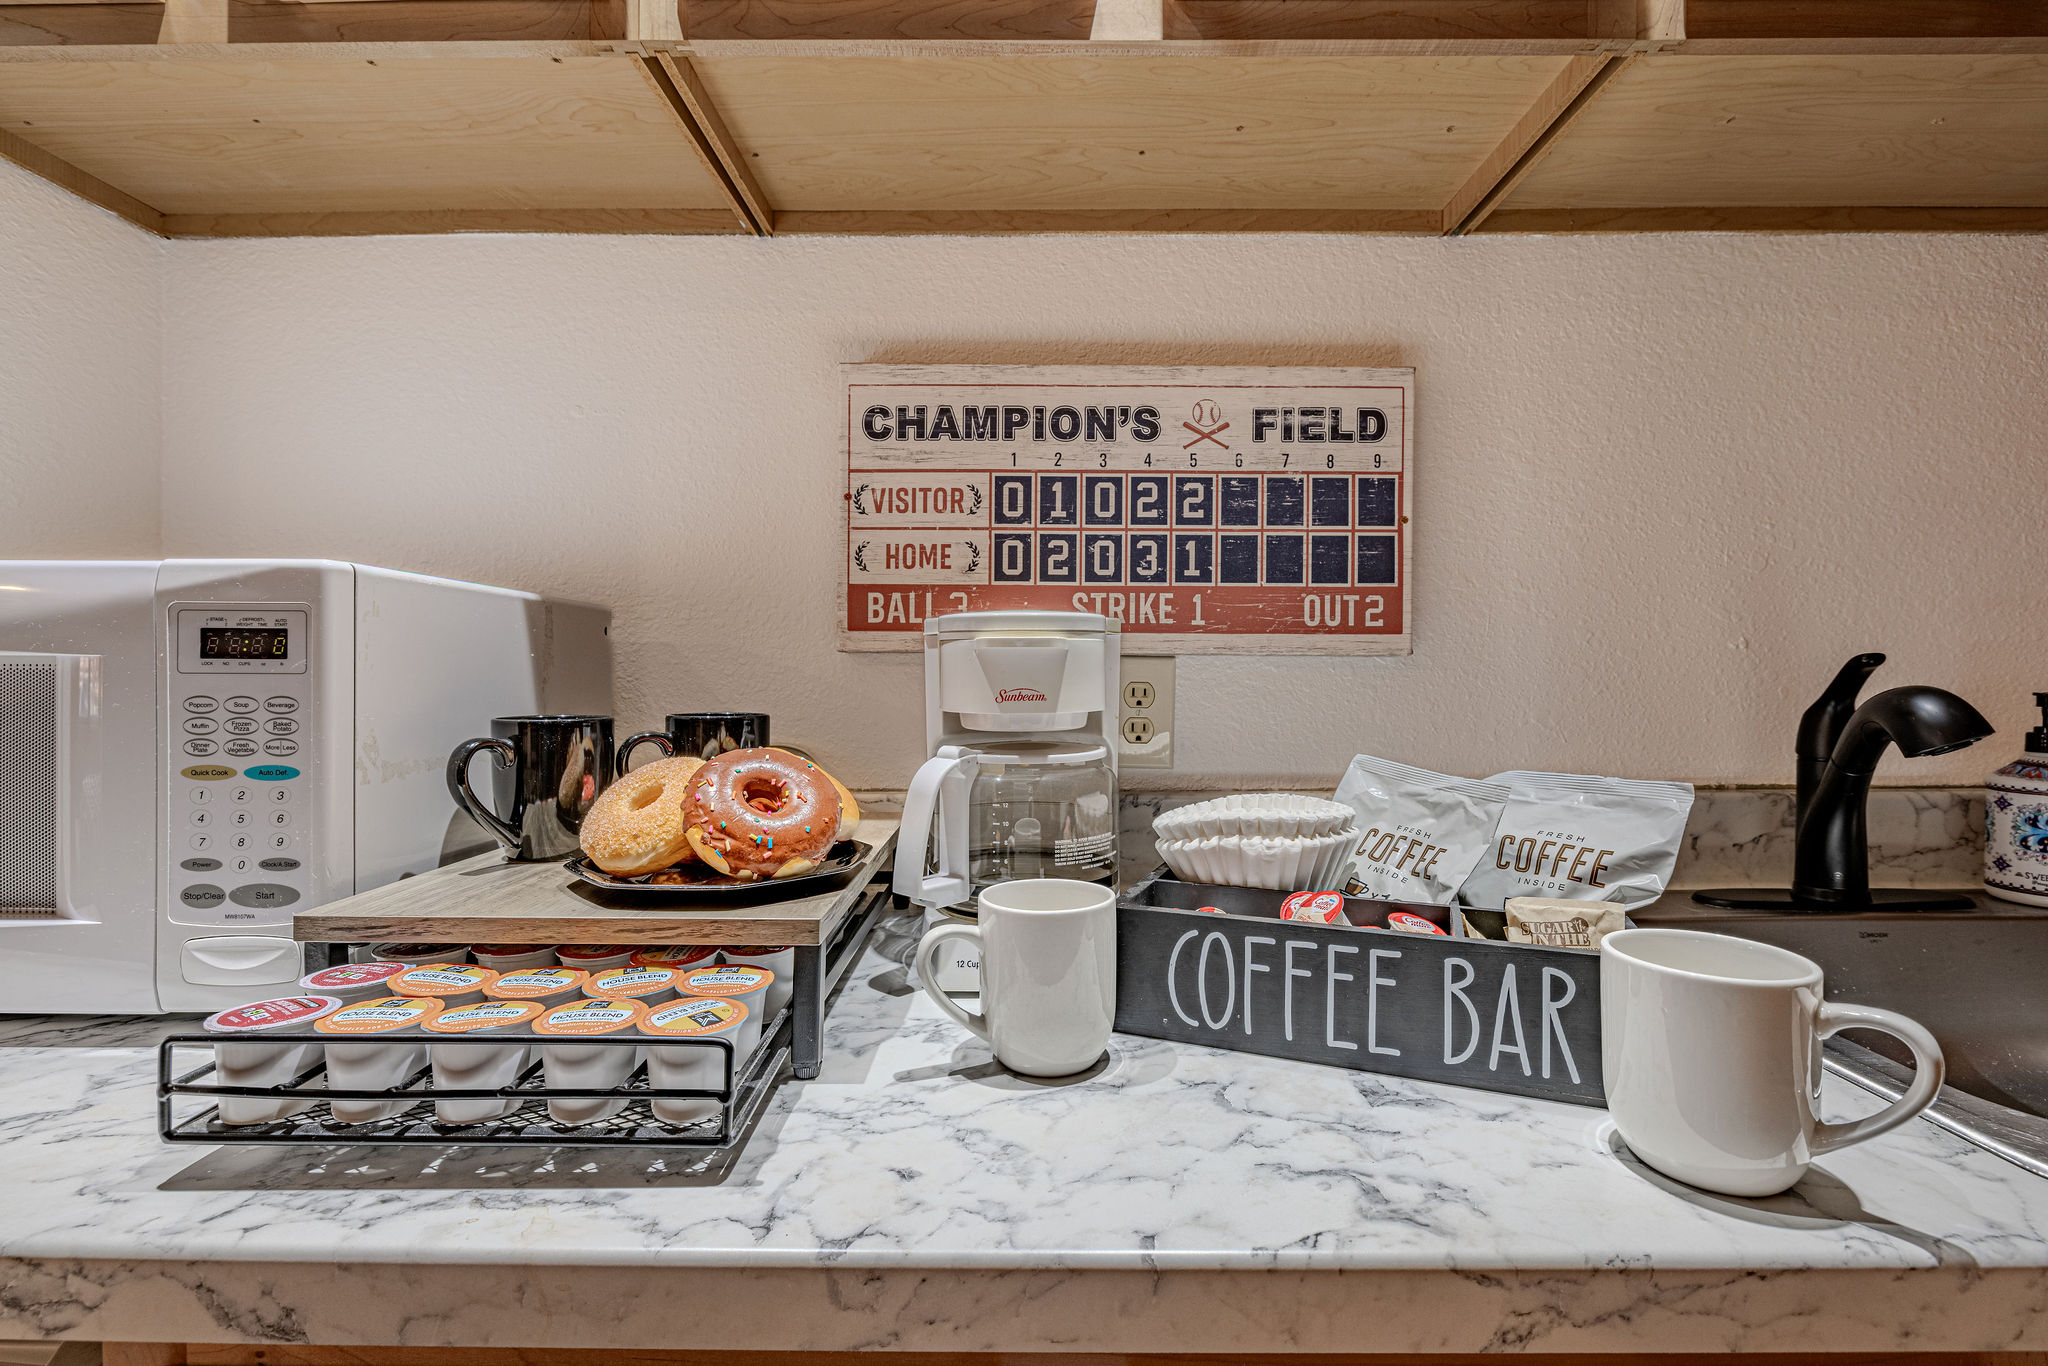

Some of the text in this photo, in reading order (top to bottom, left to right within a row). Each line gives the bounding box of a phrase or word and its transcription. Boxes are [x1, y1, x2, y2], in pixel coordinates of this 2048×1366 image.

[862, 404, 1388, 443] CHAMPION'S FIELD
[1011, 452, 1381, 468] 1 2 3 4 5 6 7 8 9
[871, 481, 1205, 518] VISITOR 0 1 0 2 2
[885, 539, 1201, 576] HOME 0 2 0 3 1
[867, 591, 933, 623] BALL
[1072, 592, 1174, 624] STRIKE
[1191, 593, 1206, 626] 1
[1303, 594, 1360, 627] OUT
[1365, 595, 1385, 627] 2
[995, 688, 1045, 704] Sunbeam
[199, 790, 204, 800] 1
[237, 790, 245, 800] 2
[276, 790, 285, 801] 3
[197, 813, 205, 823] 4
[237, 814, 245, 824] 5
[276, 813, 285, 823] 6
[1396, 824, 1432, 840] FRESH
[1536, 830, 1585, 842] FRESH
[199, 837, 206, 847] 7
[237, 837, 245, 847] 8
[276, 837, 284, 847] 9
[1354, 827, 1448, 881] COFFEE
[237, 860, 245, 870] 0
[1495, 834, 1615, 889] COFFEE
[1367, 864, 1409, 885] INSIDE
[1517, 877, 1566, 892] INSIDE
[183, 892, 225, 900] Stop/Clear
[1521, 920, 1575, 935] SUGAR
[1552, 933, 1591, 947] THE
[956, 960, 965, 968] 12
[440, 974, 472, 984] BLEND
[602, 977, 636, 986] HOUSE
[1167, 929, 1582, 1085] COFFEE BAR
[442, 1012, 482, 1021] HOUSE
[551, 1013, 588, 1021] HOUSE
